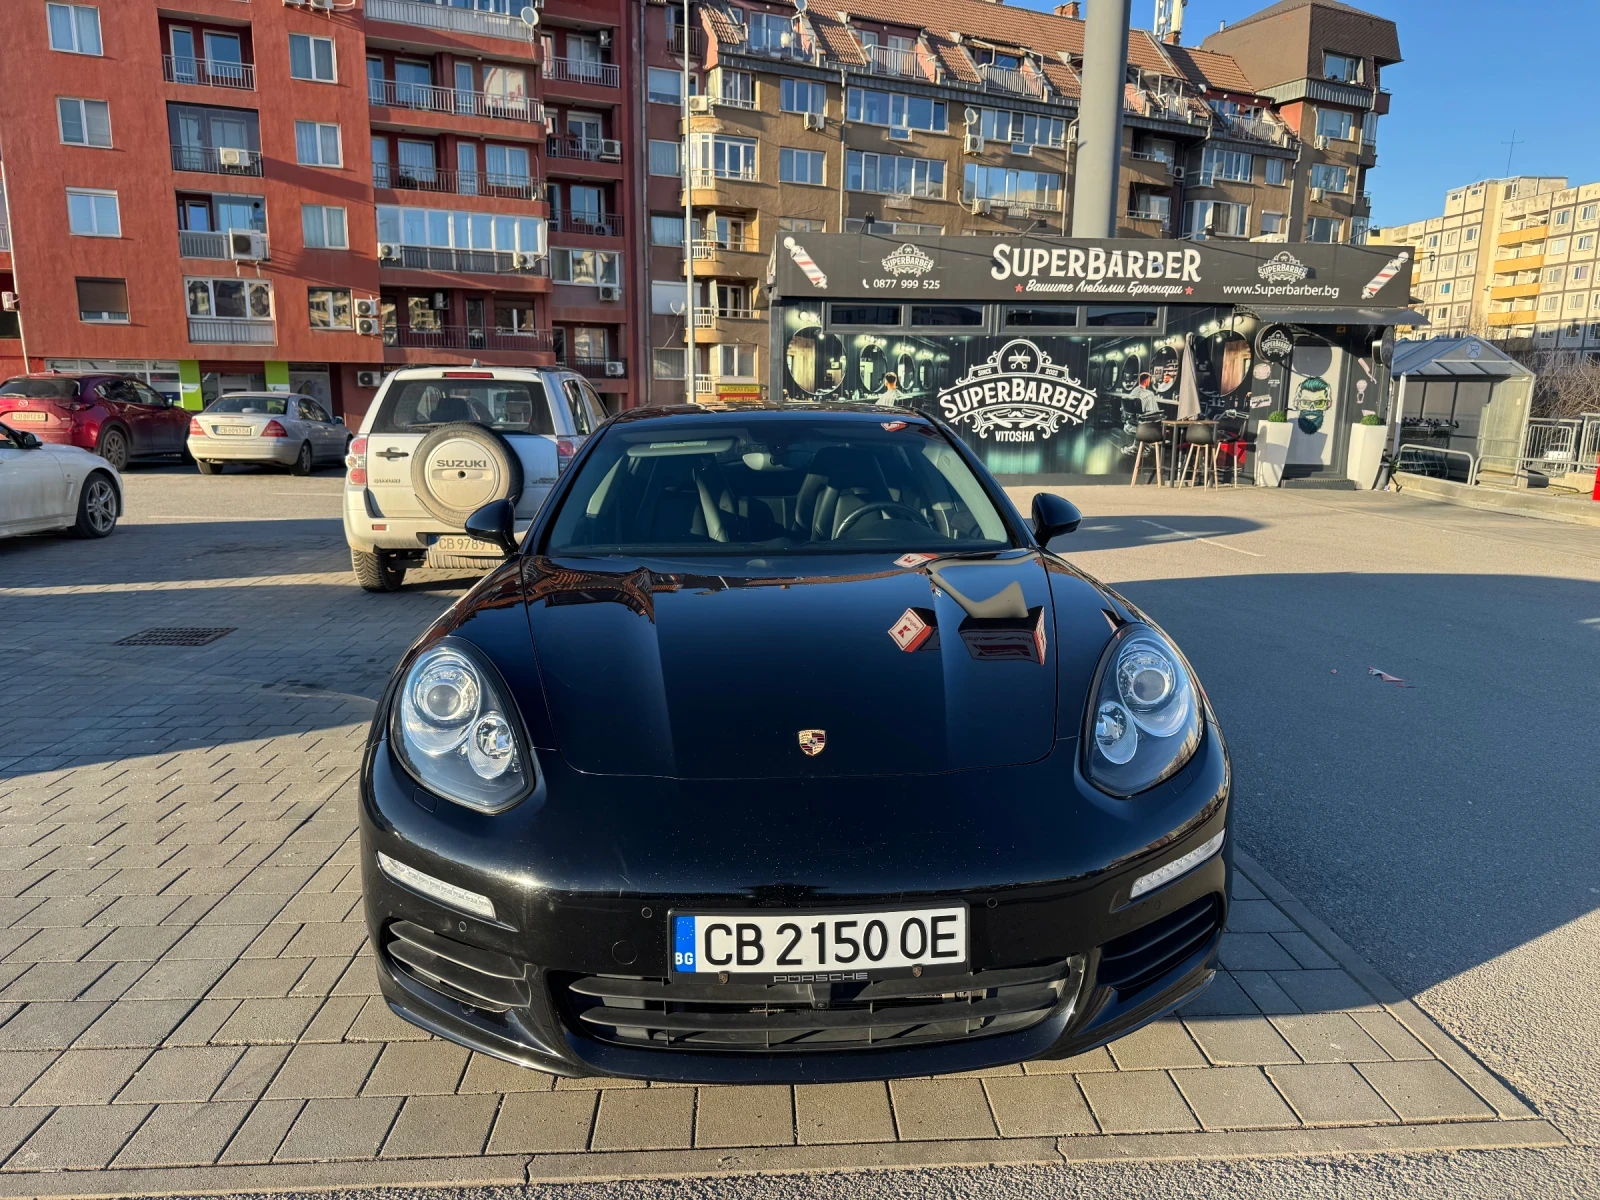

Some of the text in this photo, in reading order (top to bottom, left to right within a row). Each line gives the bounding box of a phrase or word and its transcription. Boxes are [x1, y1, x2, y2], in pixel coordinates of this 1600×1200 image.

[873, 279, 940, 290] 0877 999 525
[1025, 279, 1183, 297] Вашите Любими Бръснари
[1223, 284, 1340, 298] www.Superbarber.bg
[977, 368, 993, 377] SINCE
[995, 430, 1035, 442] VITOSHA
[436, 460, 487, 468] SUZUKI
[439, 538, 455, 550] CB
[457, 538, 485, 551] 9789
[704, 914, 959, 966] CB 2150 OE
[675, 951, 694, 965] BG
[773, 972, 868, 983] PORSCHE
